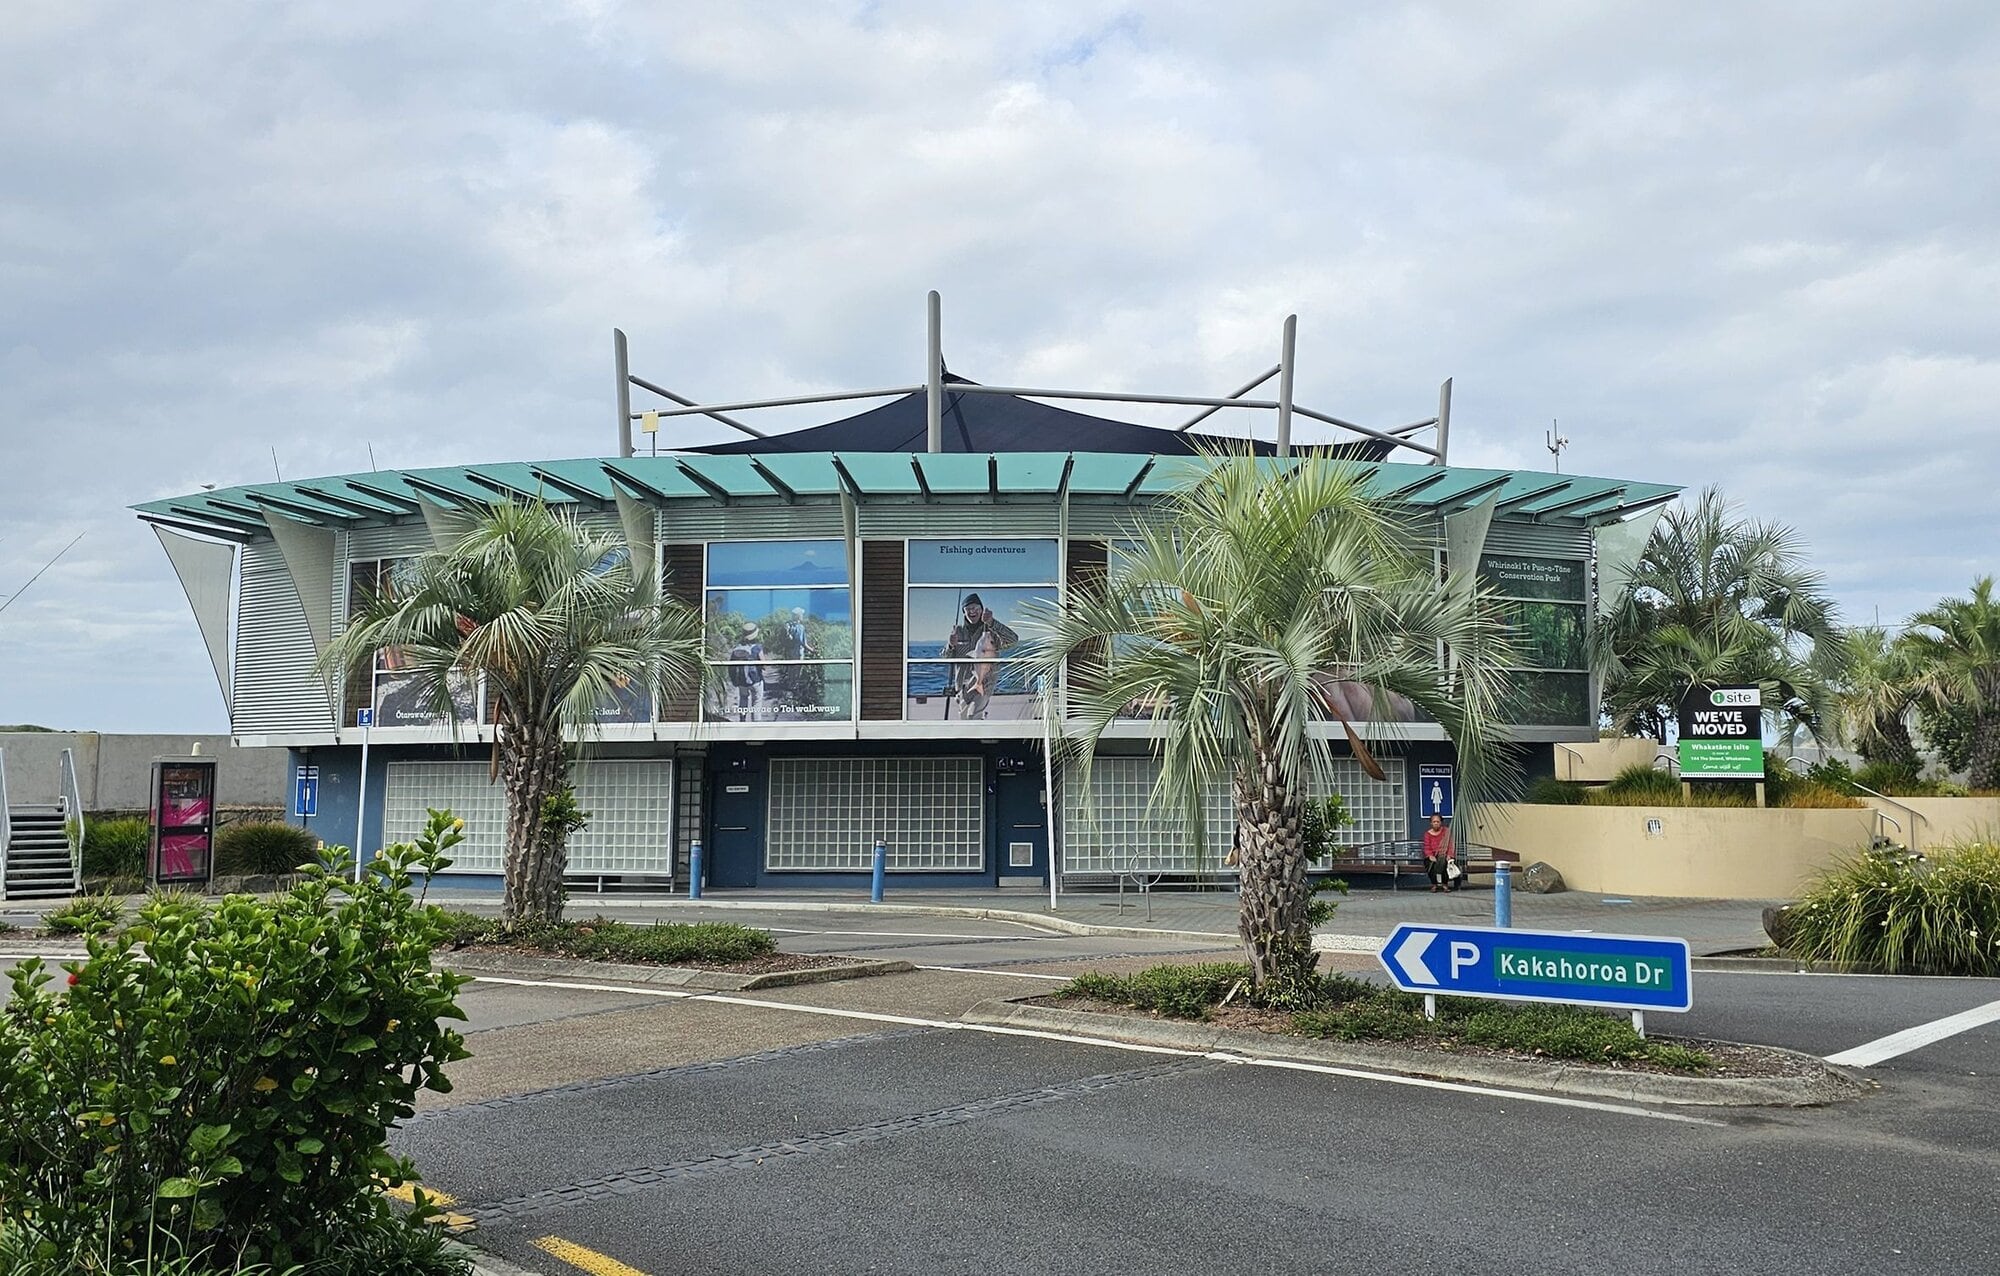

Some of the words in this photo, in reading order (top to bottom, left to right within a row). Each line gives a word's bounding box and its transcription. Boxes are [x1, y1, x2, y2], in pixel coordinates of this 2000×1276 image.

[940, 545, 973, 556] Fishing
[975, 545, 1026, 554] adventures
[1487, 560, 1522, 570] Whirinaki
[1522, 562, 1531, 571] Te
[1499, 571, 1544, 581] Conservation
[1545, 573, 1561, 582] Park
[780, 704, 794, 713] Toi
[795, 704, 840, 714] walkways
[1694, 711, 1743, 723] WE'VE
[1692, 723, 1747, 735] MOVED
[1450, 941, 1481, 980] P
[1500, 953, 1628, 983] Kakahoroa
[1635, 962, 1664, 985] Dr
